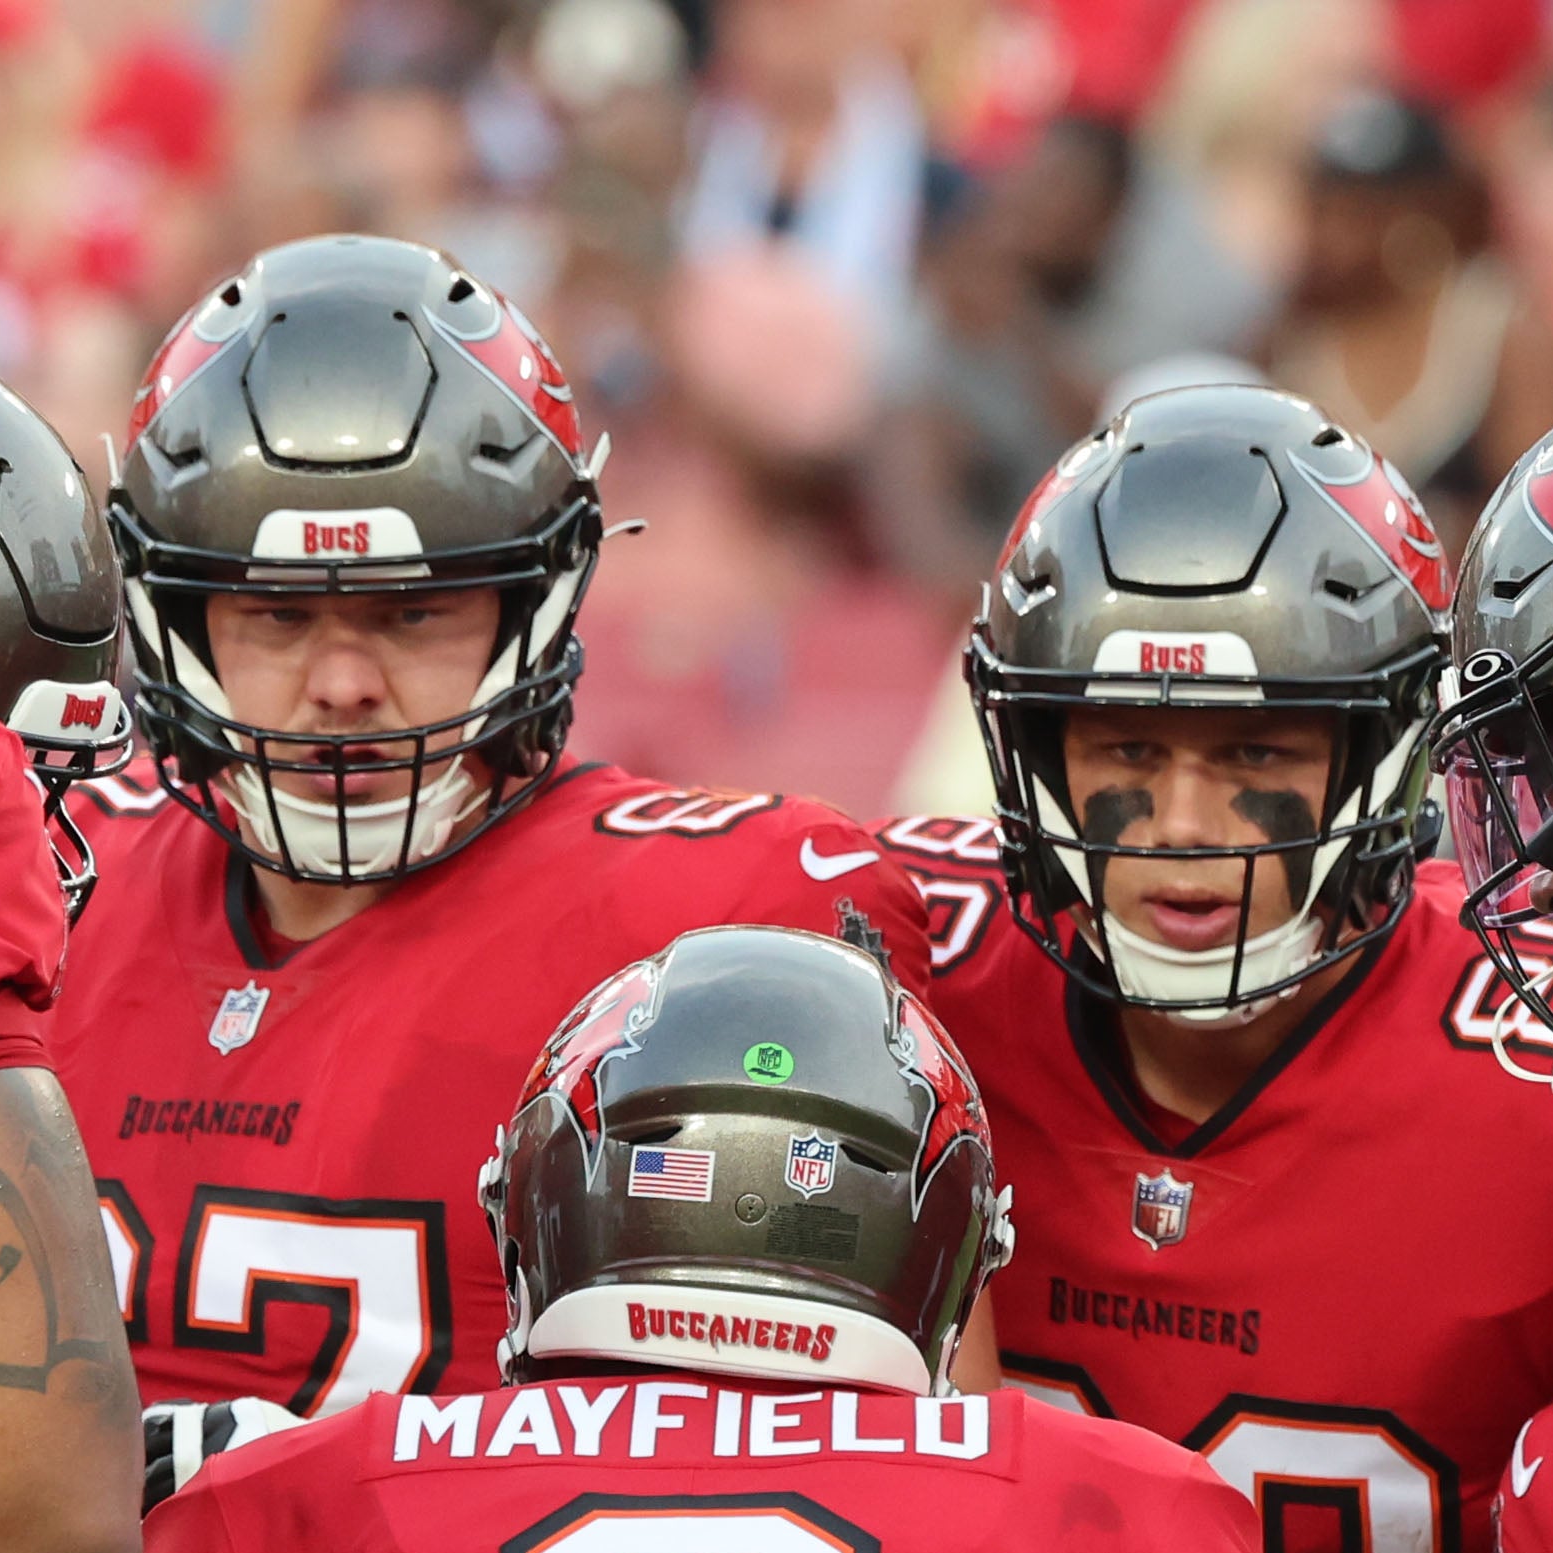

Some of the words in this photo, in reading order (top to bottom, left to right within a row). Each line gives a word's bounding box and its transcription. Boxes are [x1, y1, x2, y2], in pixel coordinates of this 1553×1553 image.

[759, 1054, 781, 1068] NFL
[119, 1095, 301, 1146] BUCCANEERS
[791, 1158, 827, 1186] NFL
[99, 1176, 446, 1422] 7
[1051, 1276, 1260, 1355] BUCCANEERS
[627, 1302, 836, 1362] BUCCANEERS
[392, 1383, 990, 1462] MAYFIELD
